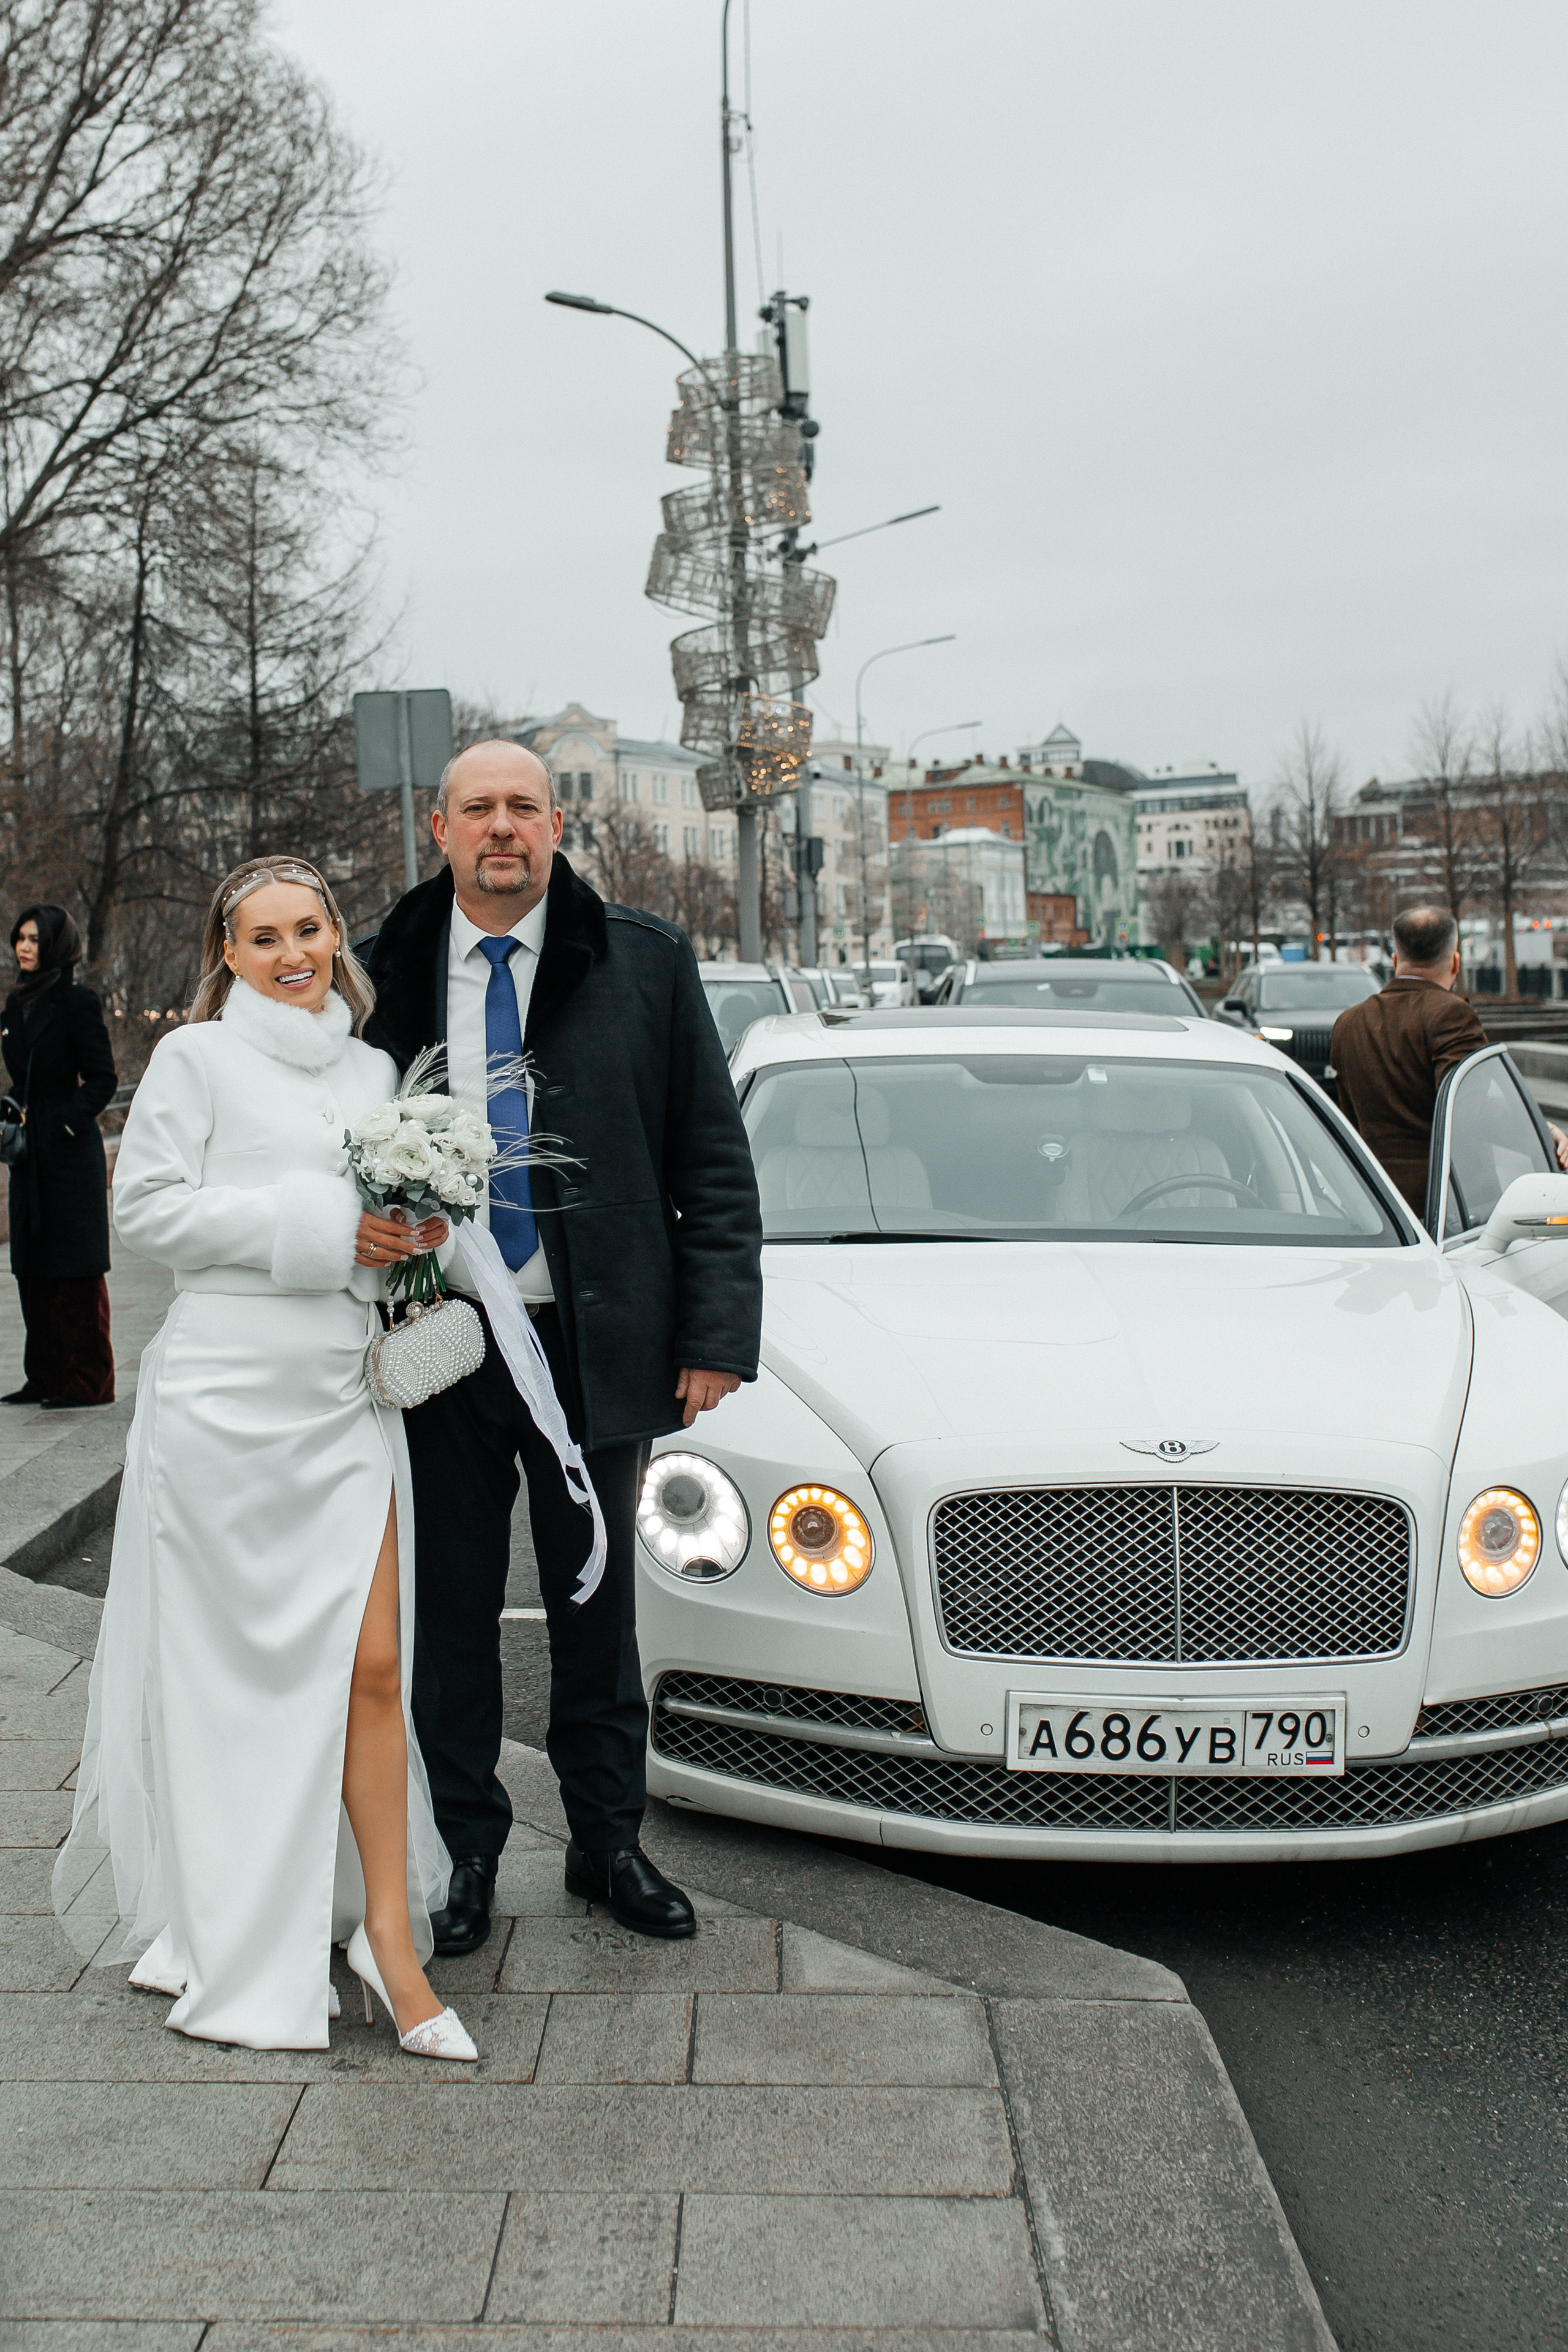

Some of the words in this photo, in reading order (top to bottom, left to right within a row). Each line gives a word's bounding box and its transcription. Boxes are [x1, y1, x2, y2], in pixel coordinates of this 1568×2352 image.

[1163, 1442, 1182, 1453] B
[1250, 1712, 1328, 1750] 790
[1267, 1752, 1305, 1766] RUS
